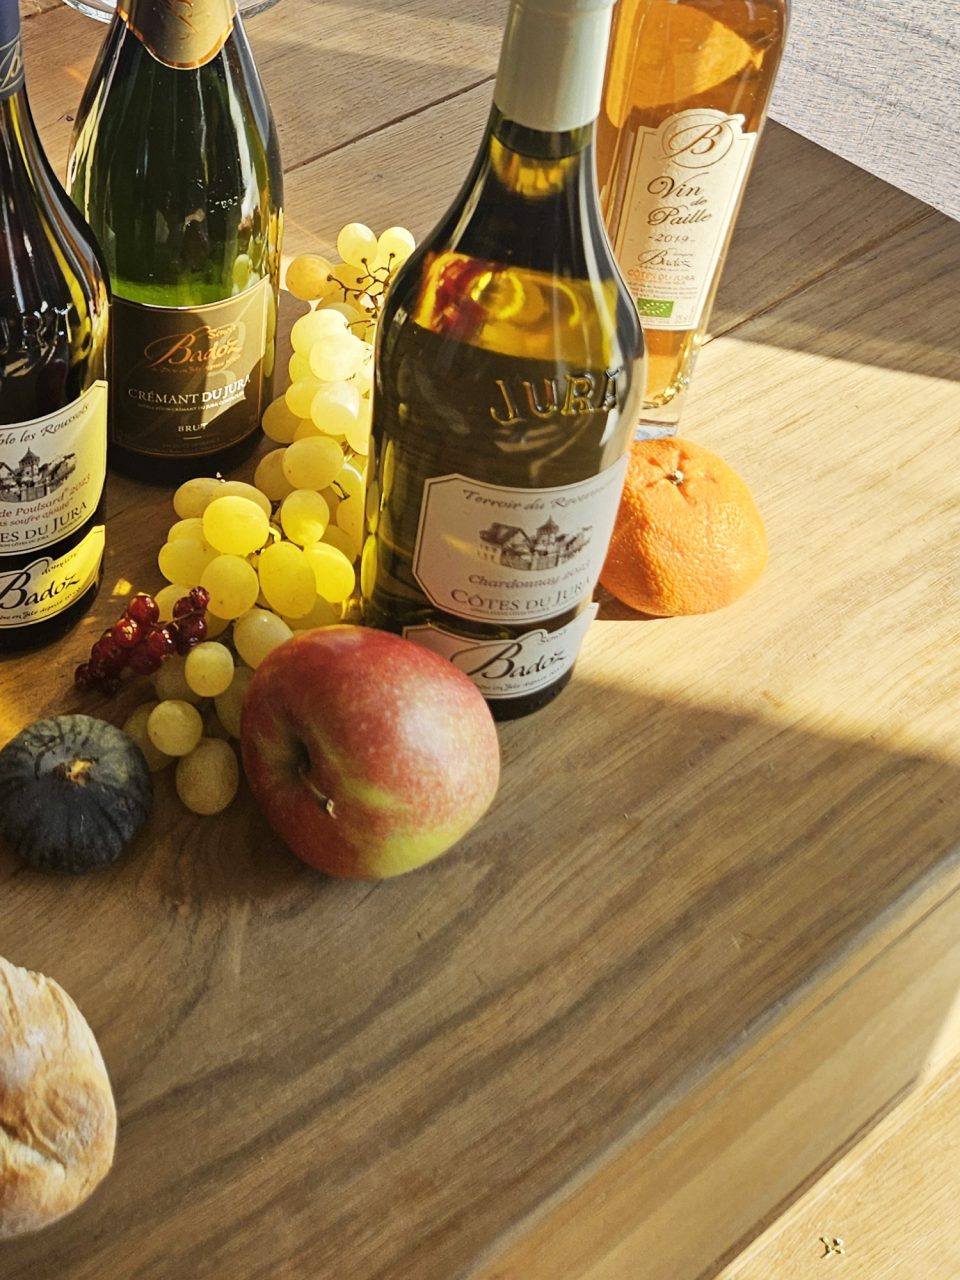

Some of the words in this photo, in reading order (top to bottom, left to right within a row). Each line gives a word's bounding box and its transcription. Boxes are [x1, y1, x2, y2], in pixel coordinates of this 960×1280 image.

[646, 171, 710, 198] Vin
[690, 195, 709, 207] de
[646, 205, 713, 227] Paille
[128, 388, 199, 405] CRÉMANT
[202, 389, 223, 404] DU
[223, 373, 252, 400] JURA
[488, 368, 623, 427] JURA
[20, 430, 36, 443] les
[178, 422, 209, 433] BRUT
[462, 488, 522, 511] Terroir
[523, 497, 545, 511] du
[25, 524, 48, 540] DU
[51, 501, 87, 535] JURA
[468, 572, 561, 591] Chardonnay
[451, 588, 520, 612] CÔTES
[526, 596, 552, 611] DU
[450, 630, 567, 680] Badoz
